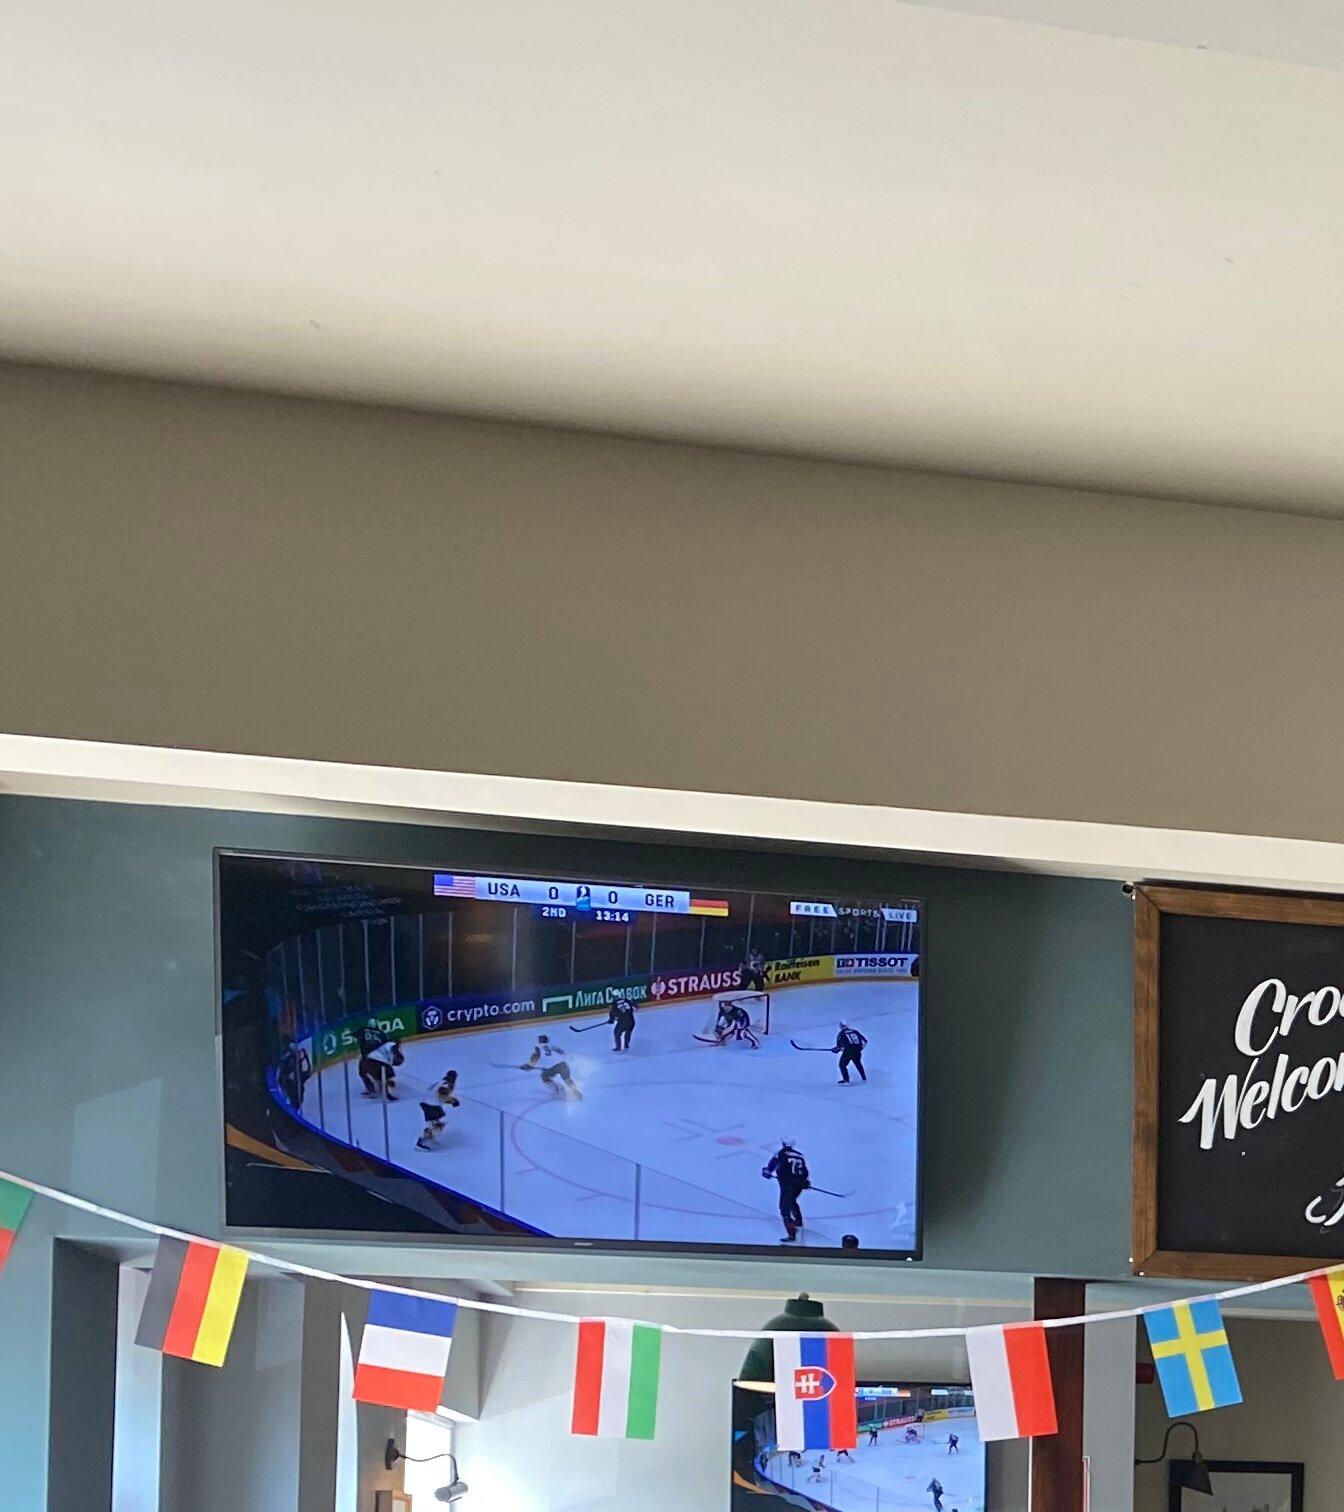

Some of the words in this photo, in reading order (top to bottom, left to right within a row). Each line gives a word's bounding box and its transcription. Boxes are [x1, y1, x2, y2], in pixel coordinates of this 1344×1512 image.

[487, 882, 521, 898] USA
[549, 887, 559, 900] 0
[608, 891, 618, 905] 0
[645, 894, 675, 908] GER
[541, 907, 566, 918] 2ND
[596, 910, 629, 923] 13:14
[795, 905, 830, 914] FREE
[838, 907, 880, 918] SPORTS
[889, 911, 912, 920] LIVE
[857, 958, 908, 968] TISSOT
[668, 969, 742, 995] STRAUSS
[447, 999, 535, 1022] crypto.com
